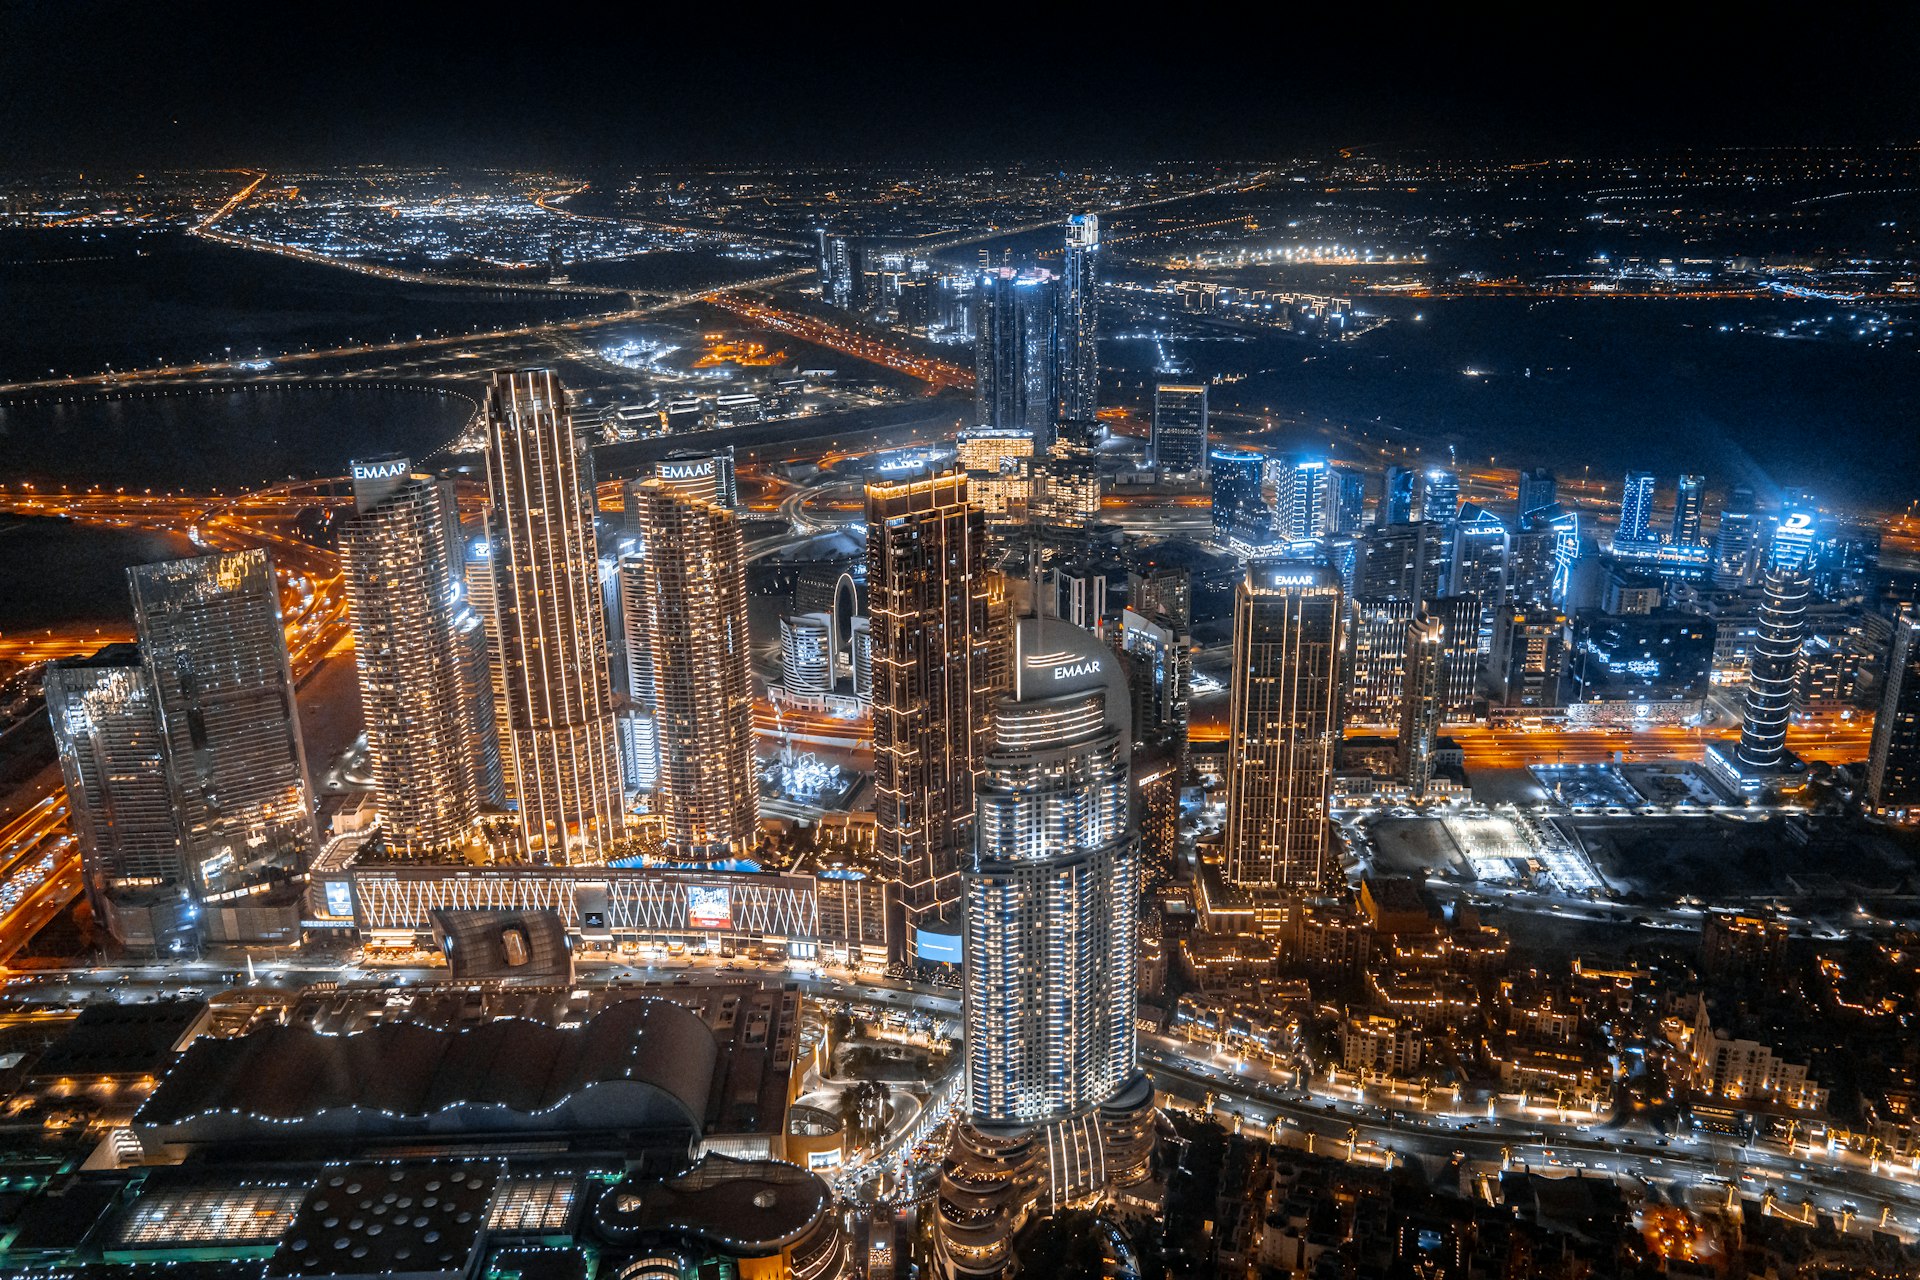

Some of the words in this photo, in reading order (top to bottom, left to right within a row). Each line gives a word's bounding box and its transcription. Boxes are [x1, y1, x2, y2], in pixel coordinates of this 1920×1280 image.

[354, 463, 406, 479] EMAAR
[662, 462, 713, 478] EMAAR
[1275, 575, 1314, 586] EMAAR
[1054, 660, 1101, 680] EMAAR
